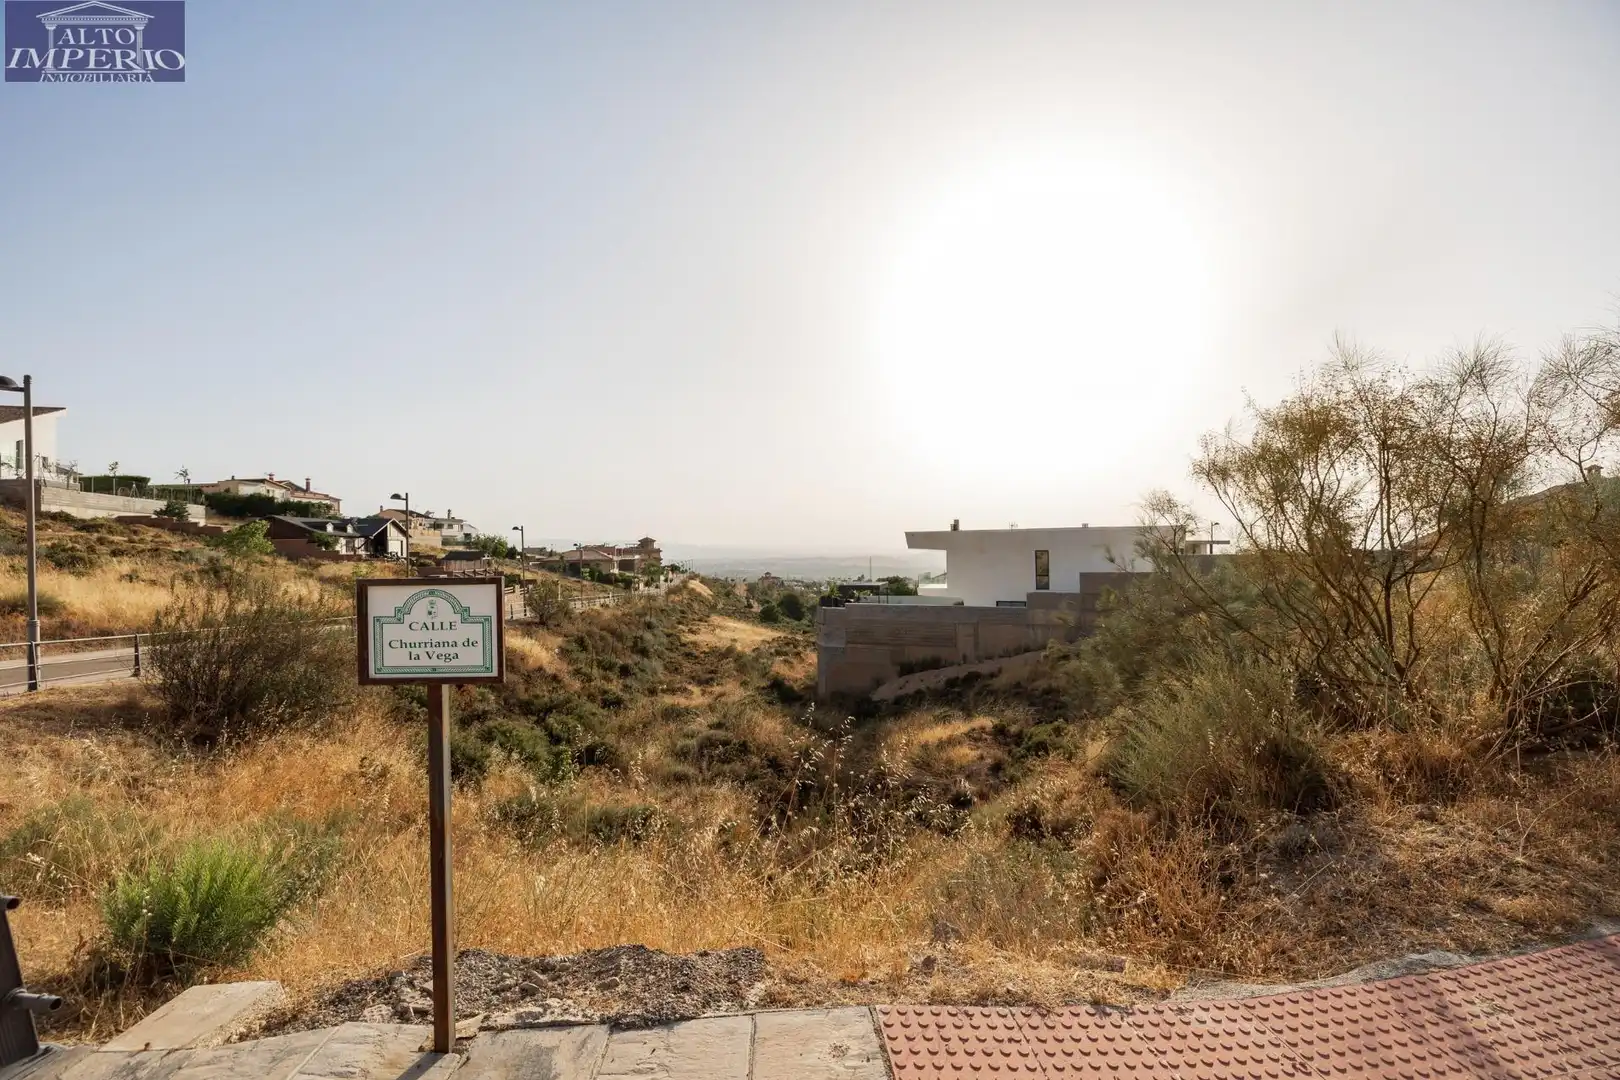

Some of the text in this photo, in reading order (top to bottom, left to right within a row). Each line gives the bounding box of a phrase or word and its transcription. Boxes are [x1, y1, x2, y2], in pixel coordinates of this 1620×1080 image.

[408, 621, 458, 632] CALLE
[388, 638, 479, 649] Churriana de
[408, 651, 460, 663] la Vega
